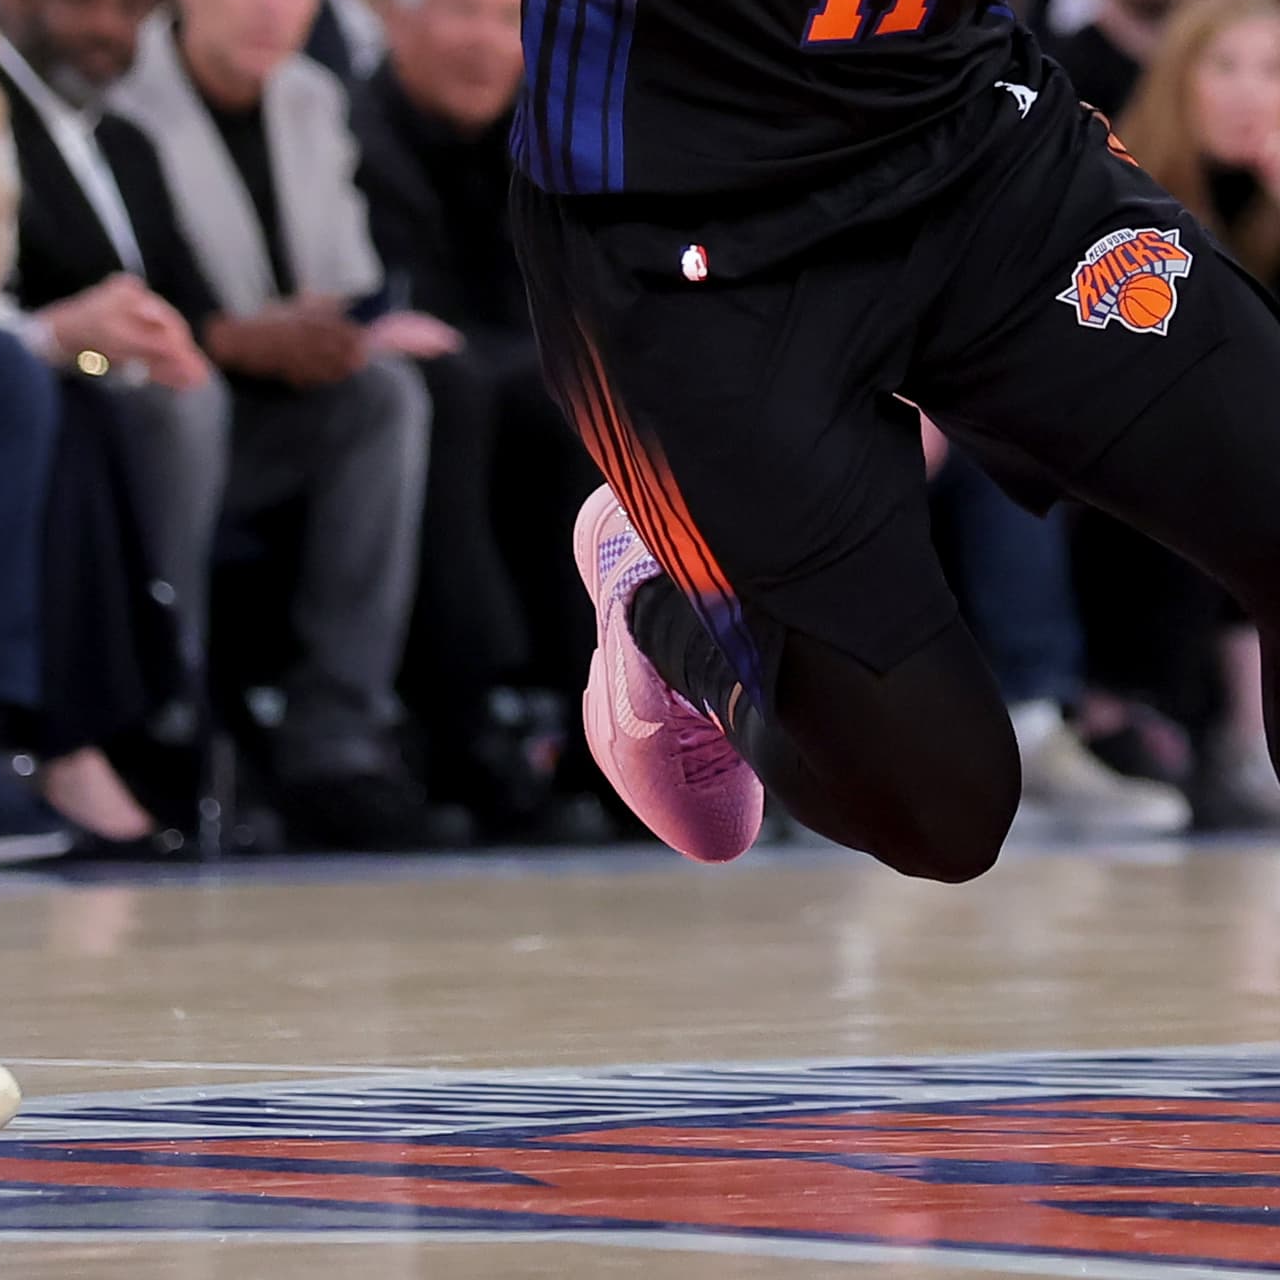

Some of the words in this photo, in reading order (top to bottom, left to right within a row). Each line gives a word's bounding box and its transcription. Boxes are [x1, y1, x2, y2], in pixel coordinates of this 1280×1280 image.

[1076, 231, 1189, 322] KNICKS
[1088, 241, 1108, 263] NEW
[1106, 228, 1135, 247] YORK
